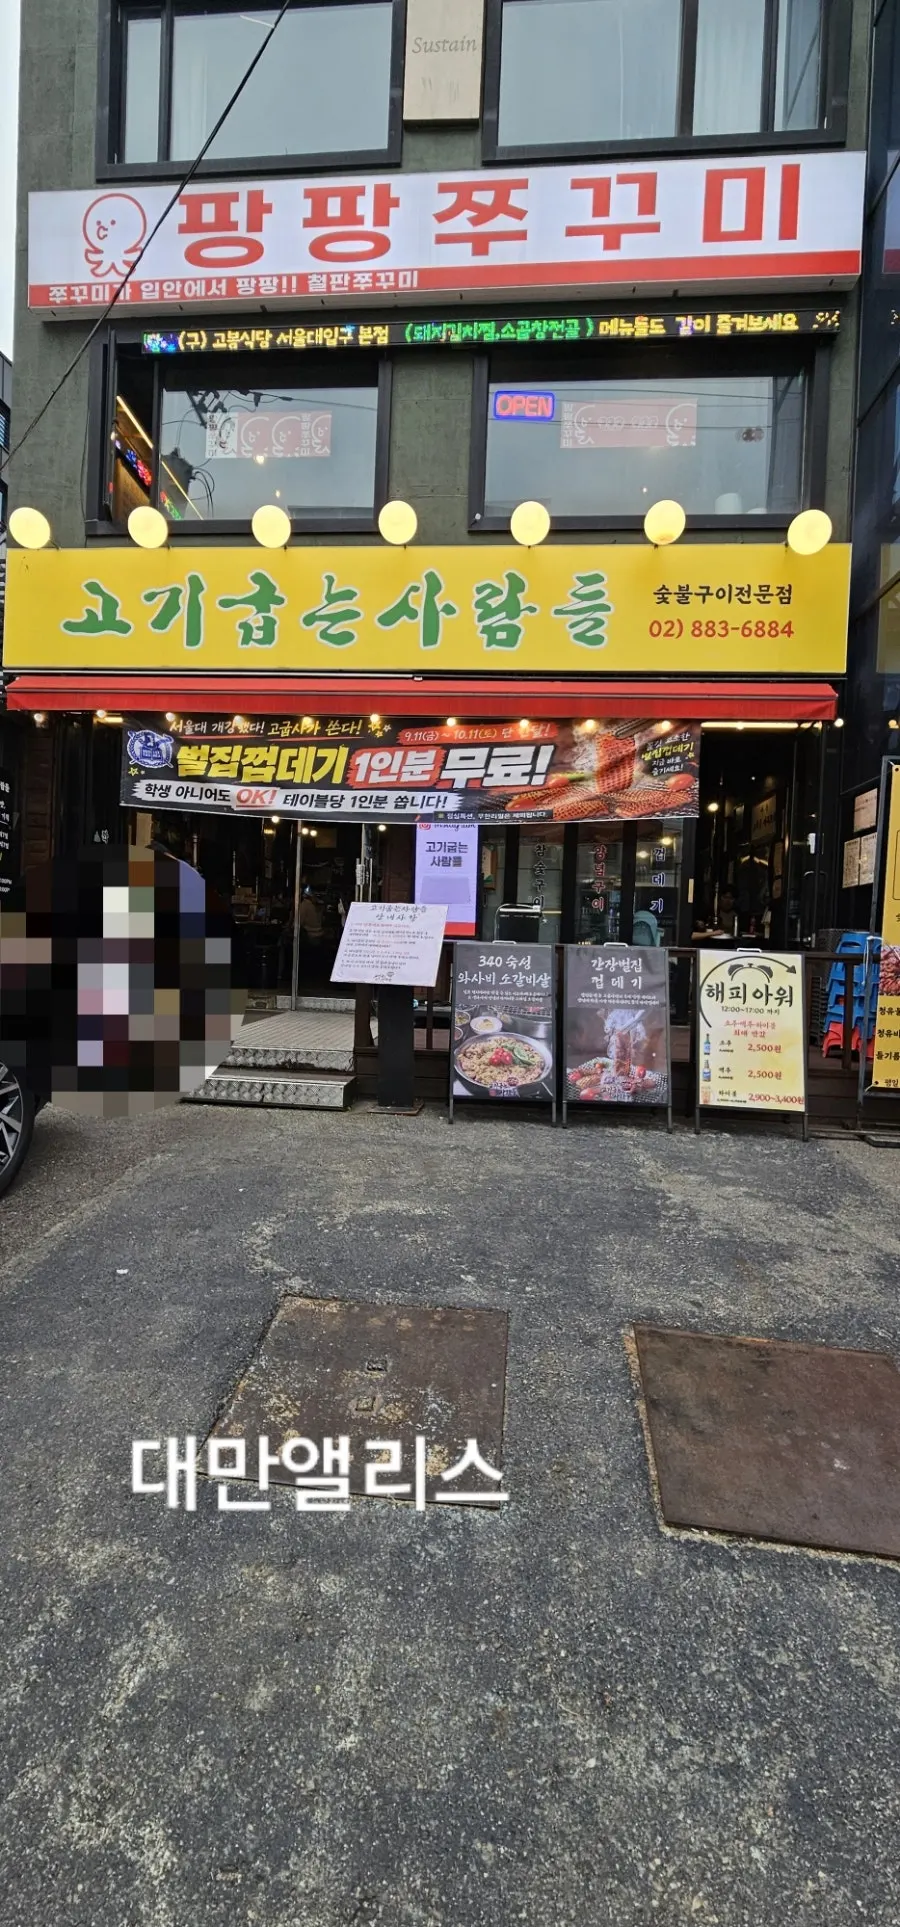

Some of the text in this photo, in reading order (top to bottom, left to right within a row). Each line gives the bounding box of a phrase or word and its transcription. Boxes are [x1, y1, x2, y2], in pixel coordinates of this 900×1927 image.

[412, 35, 477, 54] Sustain
[177, 163, 801, 268] 팡팡쭈꾸미
[49, 270, 418, 304] 쭈꾸미가 입안에서 팡팡!! 철판쭈꾸미
[178, 330, 207, 351] (구)
[212, 328, 273, 351] 고봉식당
[276, 326, 353, 348] 서울대입구
[358, 324, 389, 345] 본점
[599, 315, 666, 337] 메뉴들도
[717, 312, 799, 335] 즐겨보세요
[496, 395, 552, 418] OPEN
[653, 584, 793, 605] 숯불구이전문점
[62, 569, 614, 650] 고기굽는사람들
[649, 618, 795, 639] 02) 883-6884
[169, 719, 208, 735] 서울대
[405, 730, 440, 742] 9.11(금)
[454, 728, 497, 740] 10.11(토)
[177, 744, 555, 789] 벌집껍데기 1인분 무료!
[145, 783, 172, 799] 학생
[175, 785, 231, 802] 아니어도
[236, 788, 278, 805] OK!
[283, 793, 346, 809] 테이블당
[351, 795, 389, 810] 1인분
[425, 841, 469, 854] 고기굽는
[478, 954, 532, 970] 340 숙성
[591, 956, 642, 973] 간장벌집
[457, 970, 552, 989] 와사비 소갈비살
[721, 1006, 780, 1016] 12:00~17:00 까지
[747, 1043, 782, 1054] 2,500원
[747, 1070, 782, 1081] 2,500원
